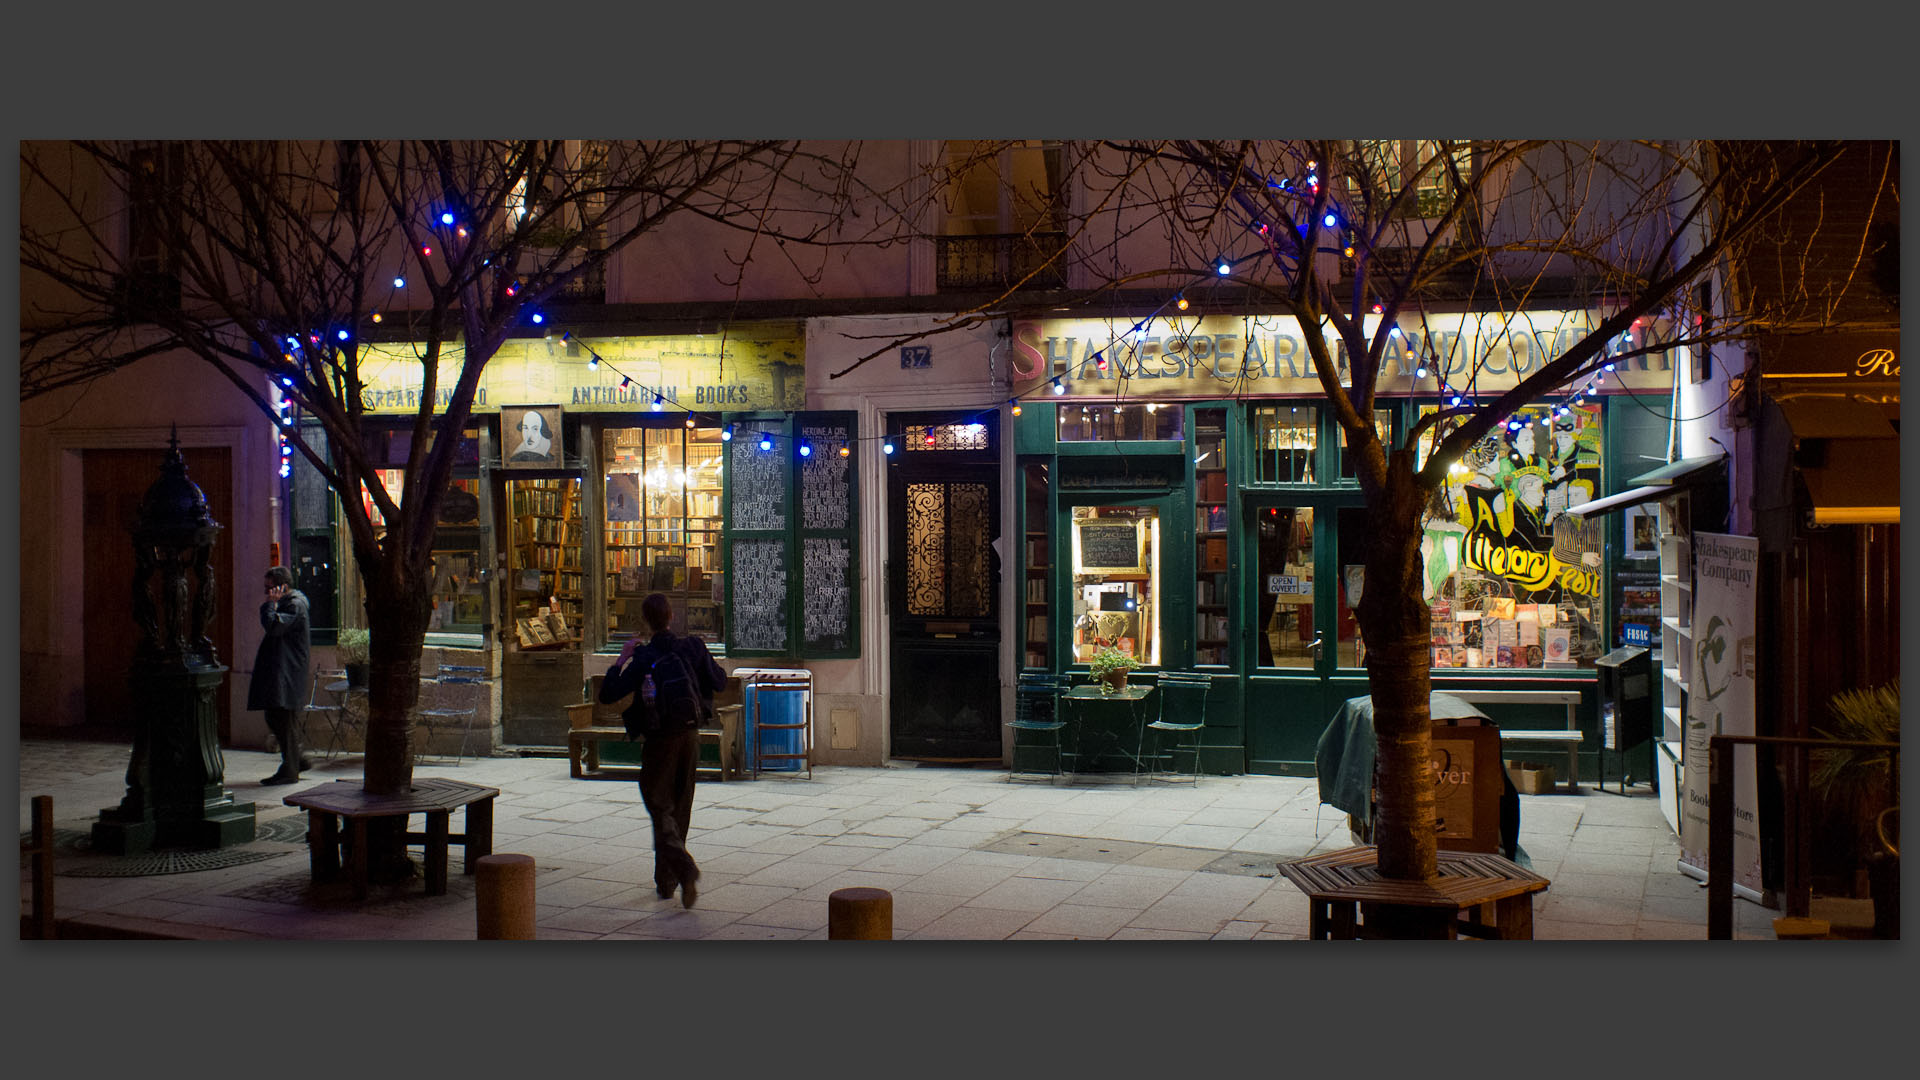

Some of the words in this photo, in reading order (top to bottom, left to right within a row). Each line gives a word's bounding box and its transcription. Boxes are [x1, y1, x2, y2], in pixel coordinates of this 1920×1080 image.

[904, 348, 928, 368] 37
[1012, 322, 1329, 381] SHAKESPEARE
[1380, 329, 1468, 377] AND
[1480, 325, 1675, 376] COMNY
[434, 387, 453, 406] AN
[695, 384, 748, 404] BOOKS
[1473, 495, 1498, 533] A
[1465, 530, 1550, 584] Literary
[1695, 535, 1758, 566] Shakespeare
[1272, 577, 1293, 585] OPEN
[1702, 557, 1753, 588] Company
[1271, 585, 1297, 593] OUVERT
[1436, 770, 1471, 785] ver
[1732, 803, 1754, 824] tore
